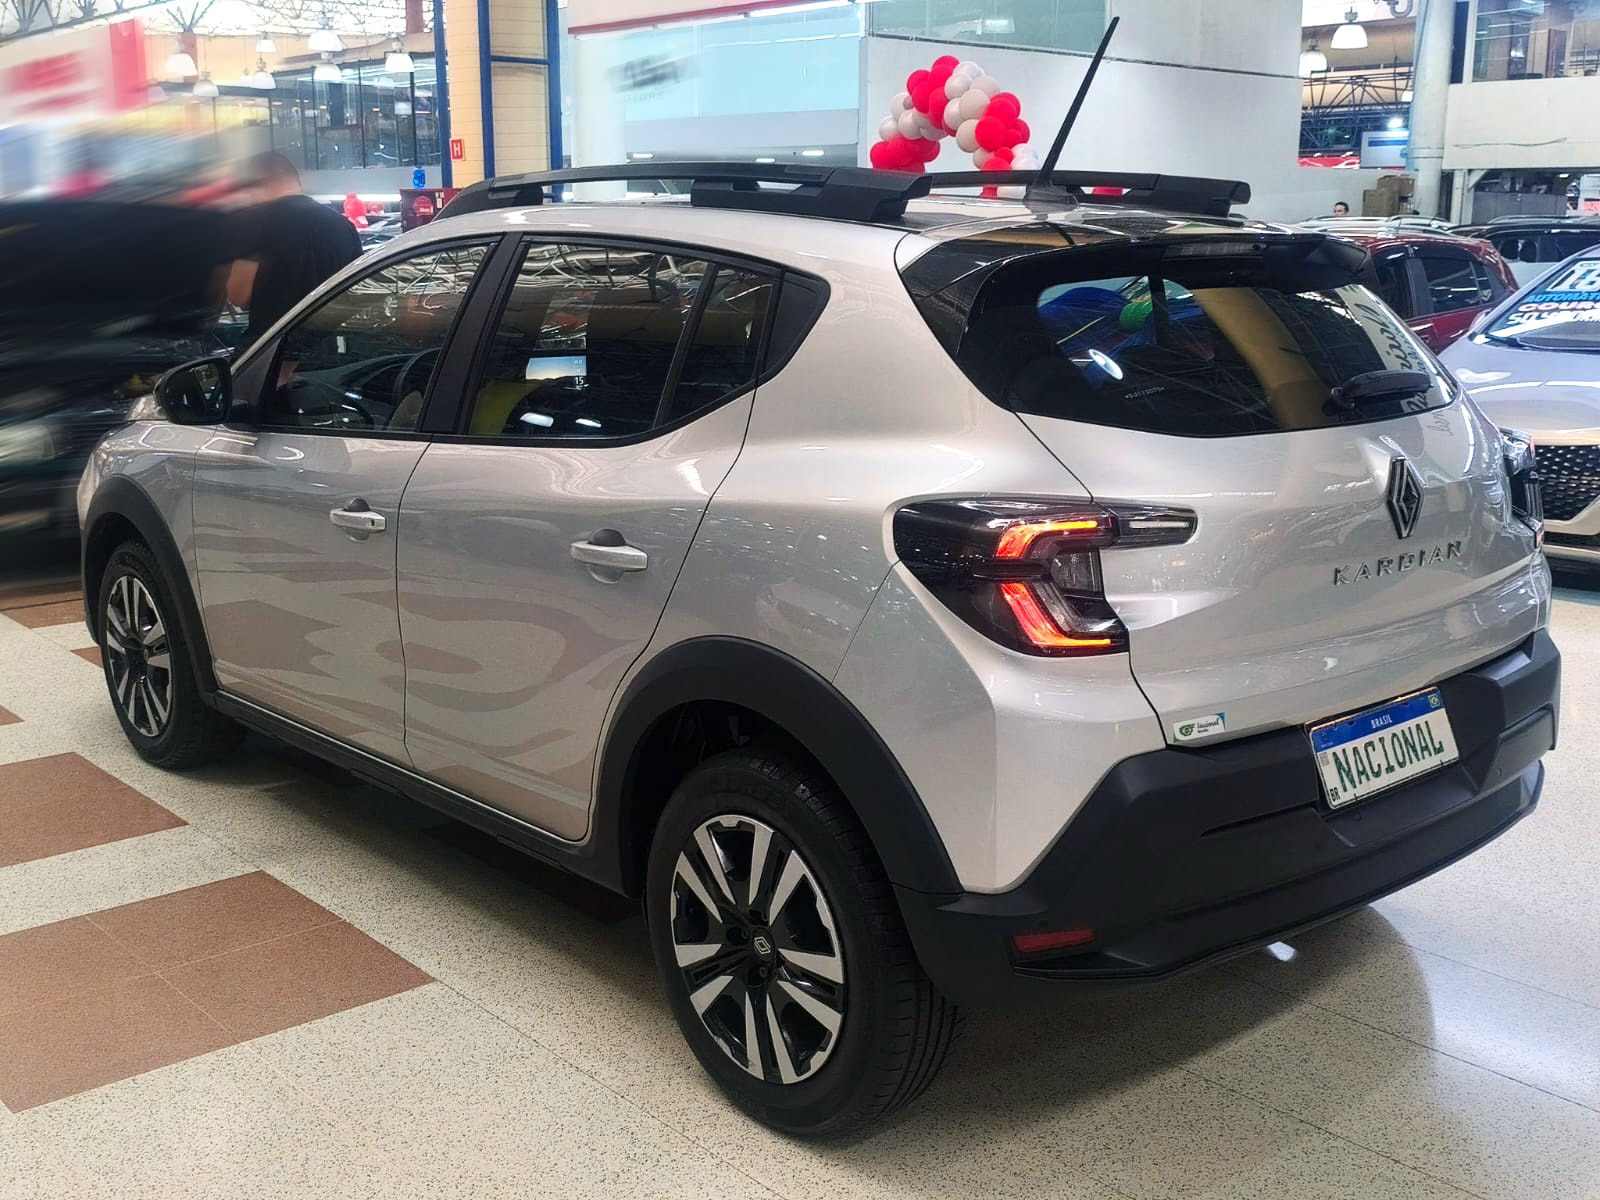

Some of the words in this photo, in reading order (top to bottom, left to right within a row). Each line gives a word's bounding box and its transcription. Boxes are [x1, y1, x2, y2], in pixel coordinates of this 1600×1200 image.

[1333, 540, 1461, 586] KARDIAN
[1370, 714, 1393, 729] BRASIL
[1332, 720, 1444, 793] NACIONAL
[1329, 787, 1341, 802] BR
